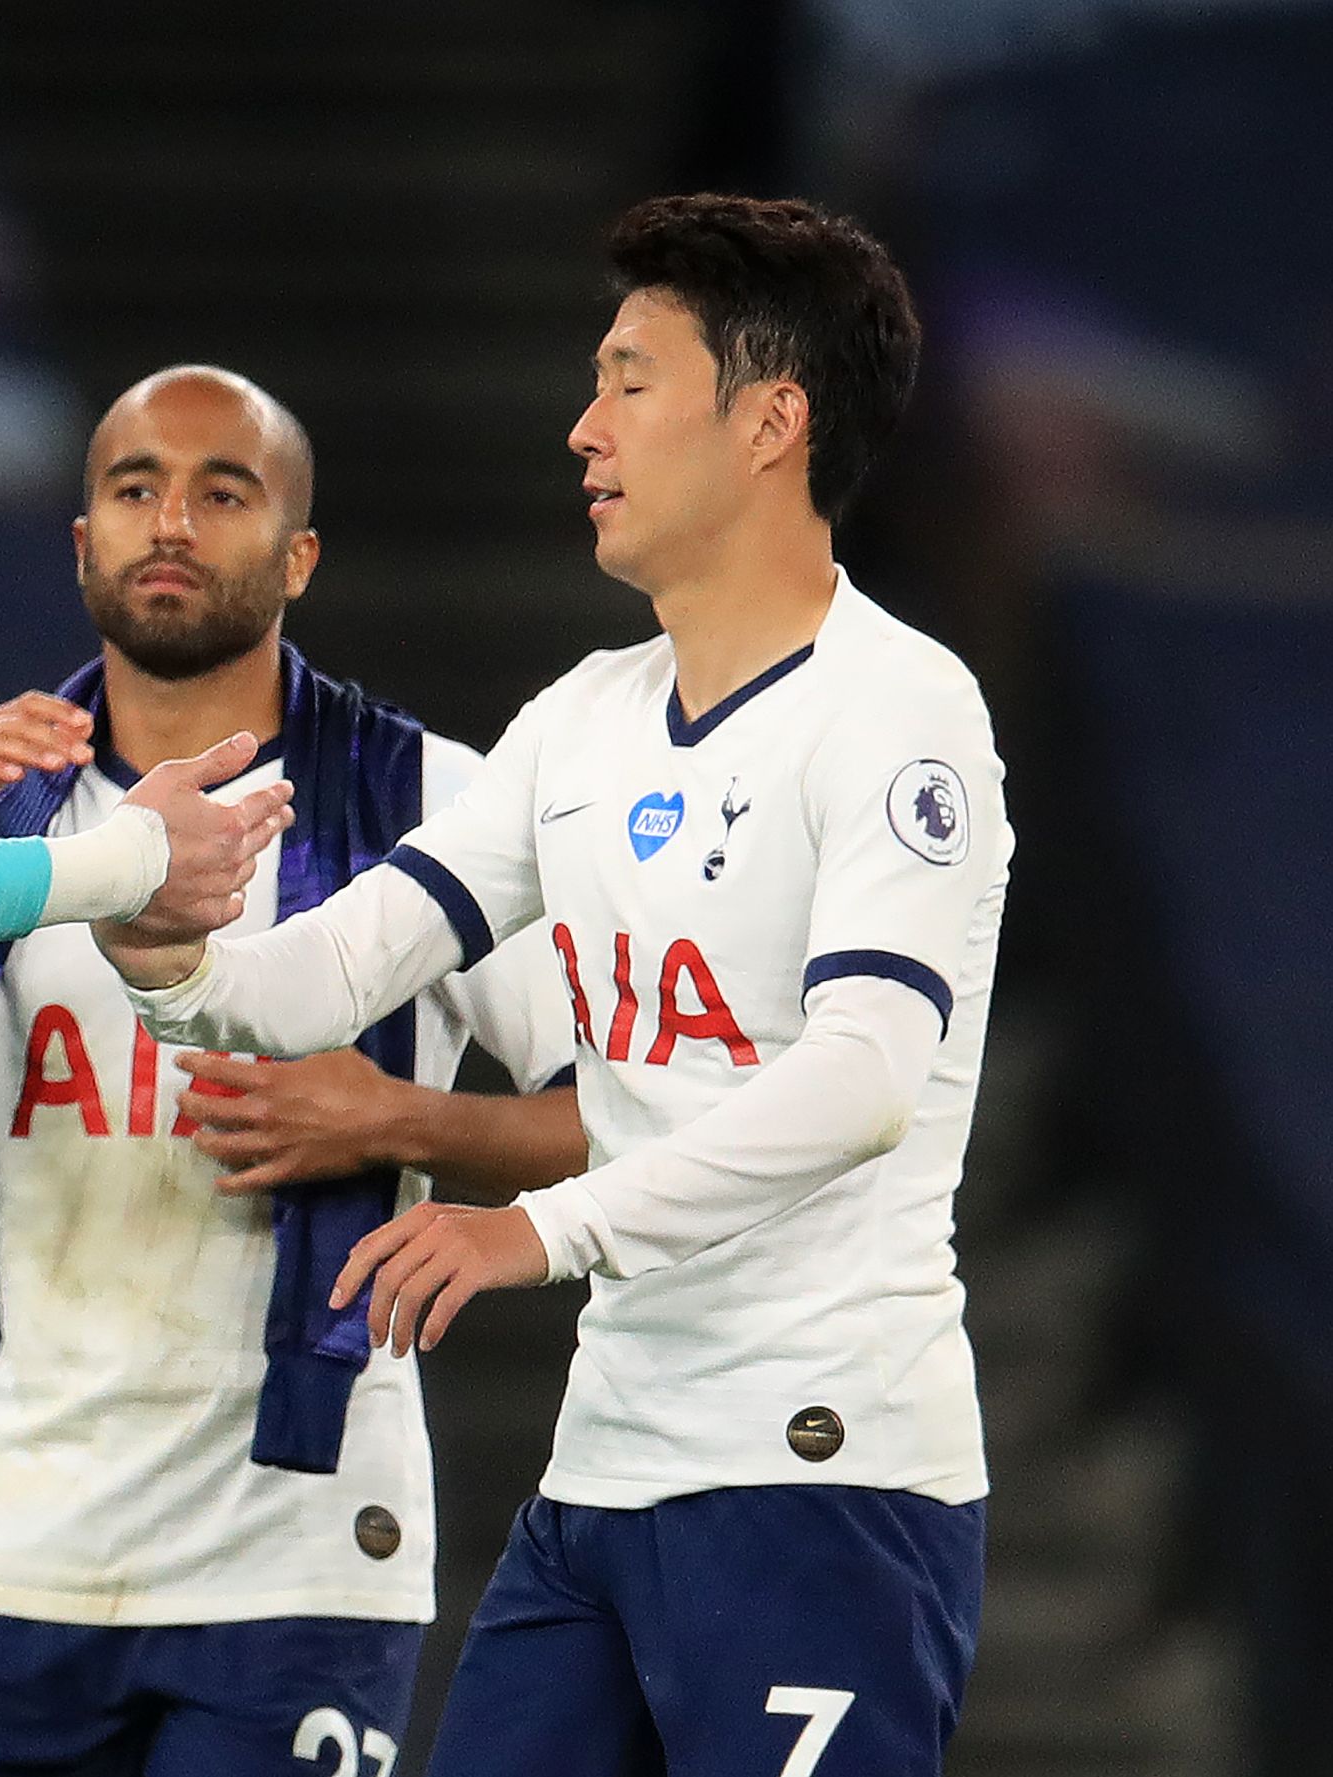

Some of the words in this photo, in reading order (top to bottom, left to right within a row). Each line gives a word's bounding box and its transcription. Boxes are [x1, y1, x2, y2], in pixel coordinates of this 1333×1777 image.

[637, 813, 676, 833] NHS
[293, 1707, 400, 1777] 27
[765, 1685, 856, 1777] 7
